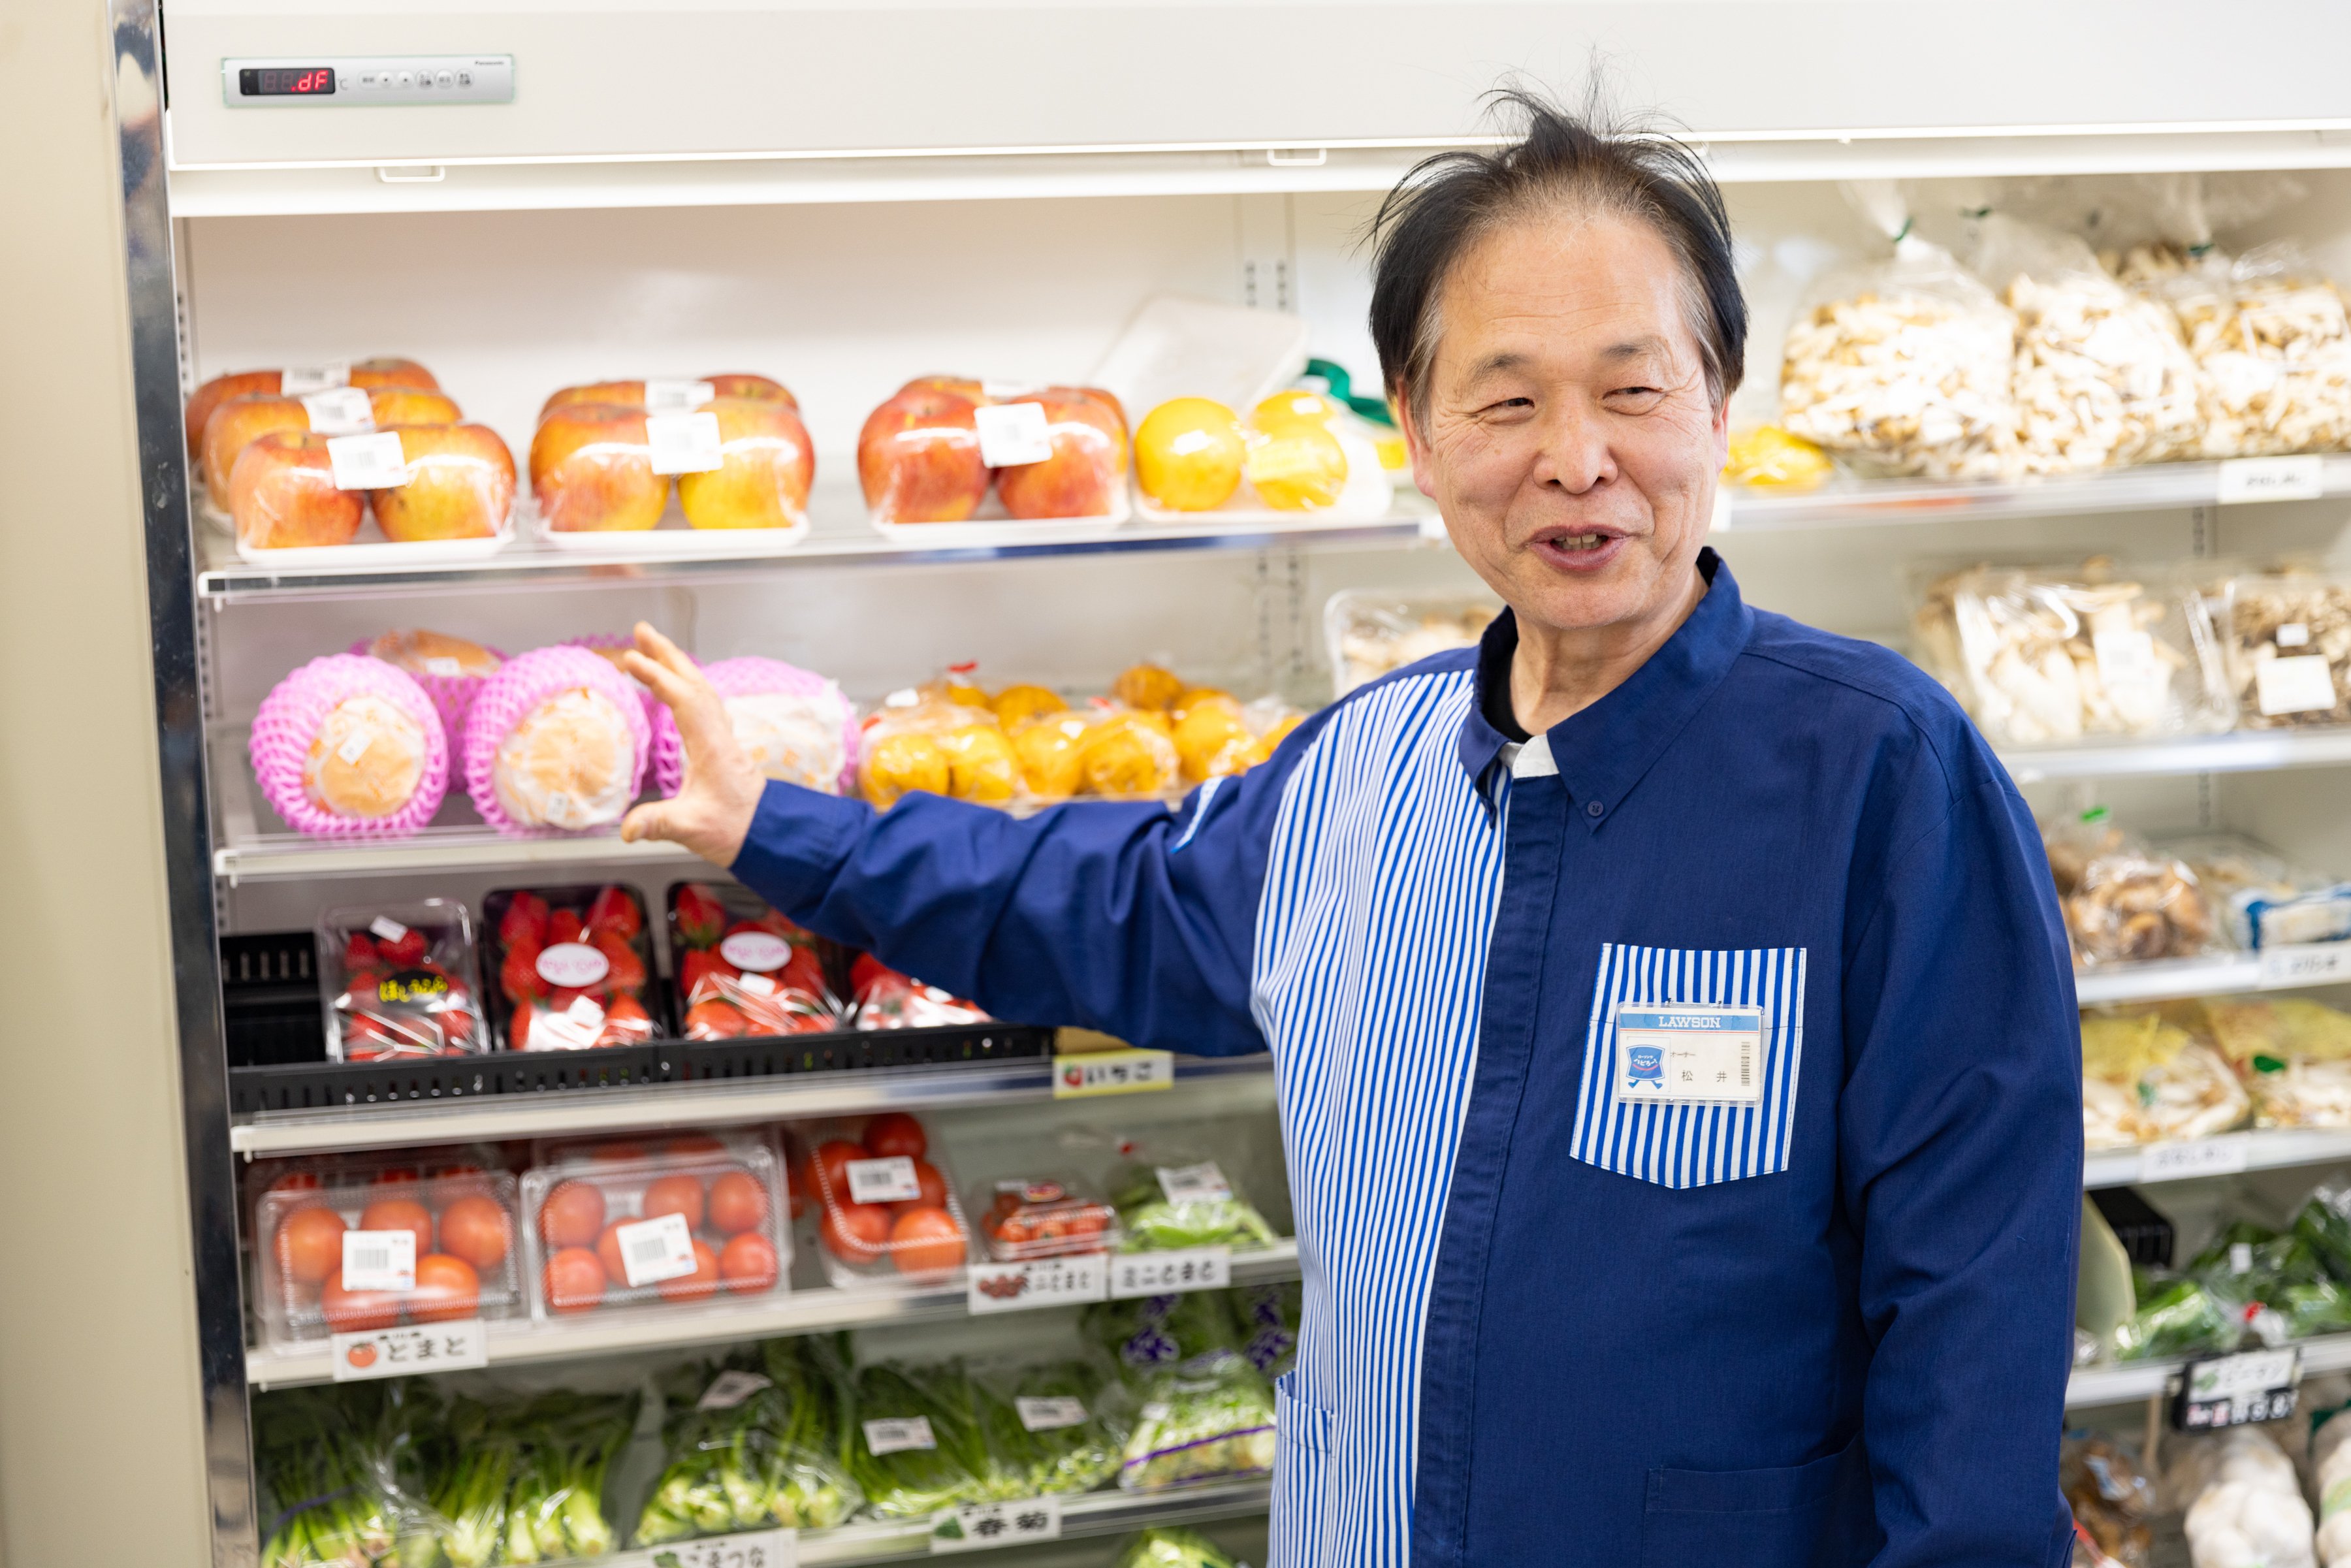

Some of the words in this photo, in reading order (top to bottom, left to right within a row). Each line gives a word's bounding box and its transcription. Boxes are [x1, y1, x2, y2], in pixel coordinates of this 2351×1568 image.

[1659, 1016, 1721, 1028] LAWSON
[1122, 1260, 1217, 1289] ミニとまと
[388, 1336, 467, 1362] とまと
[974, 1511, 1048, 1538] 春菊
